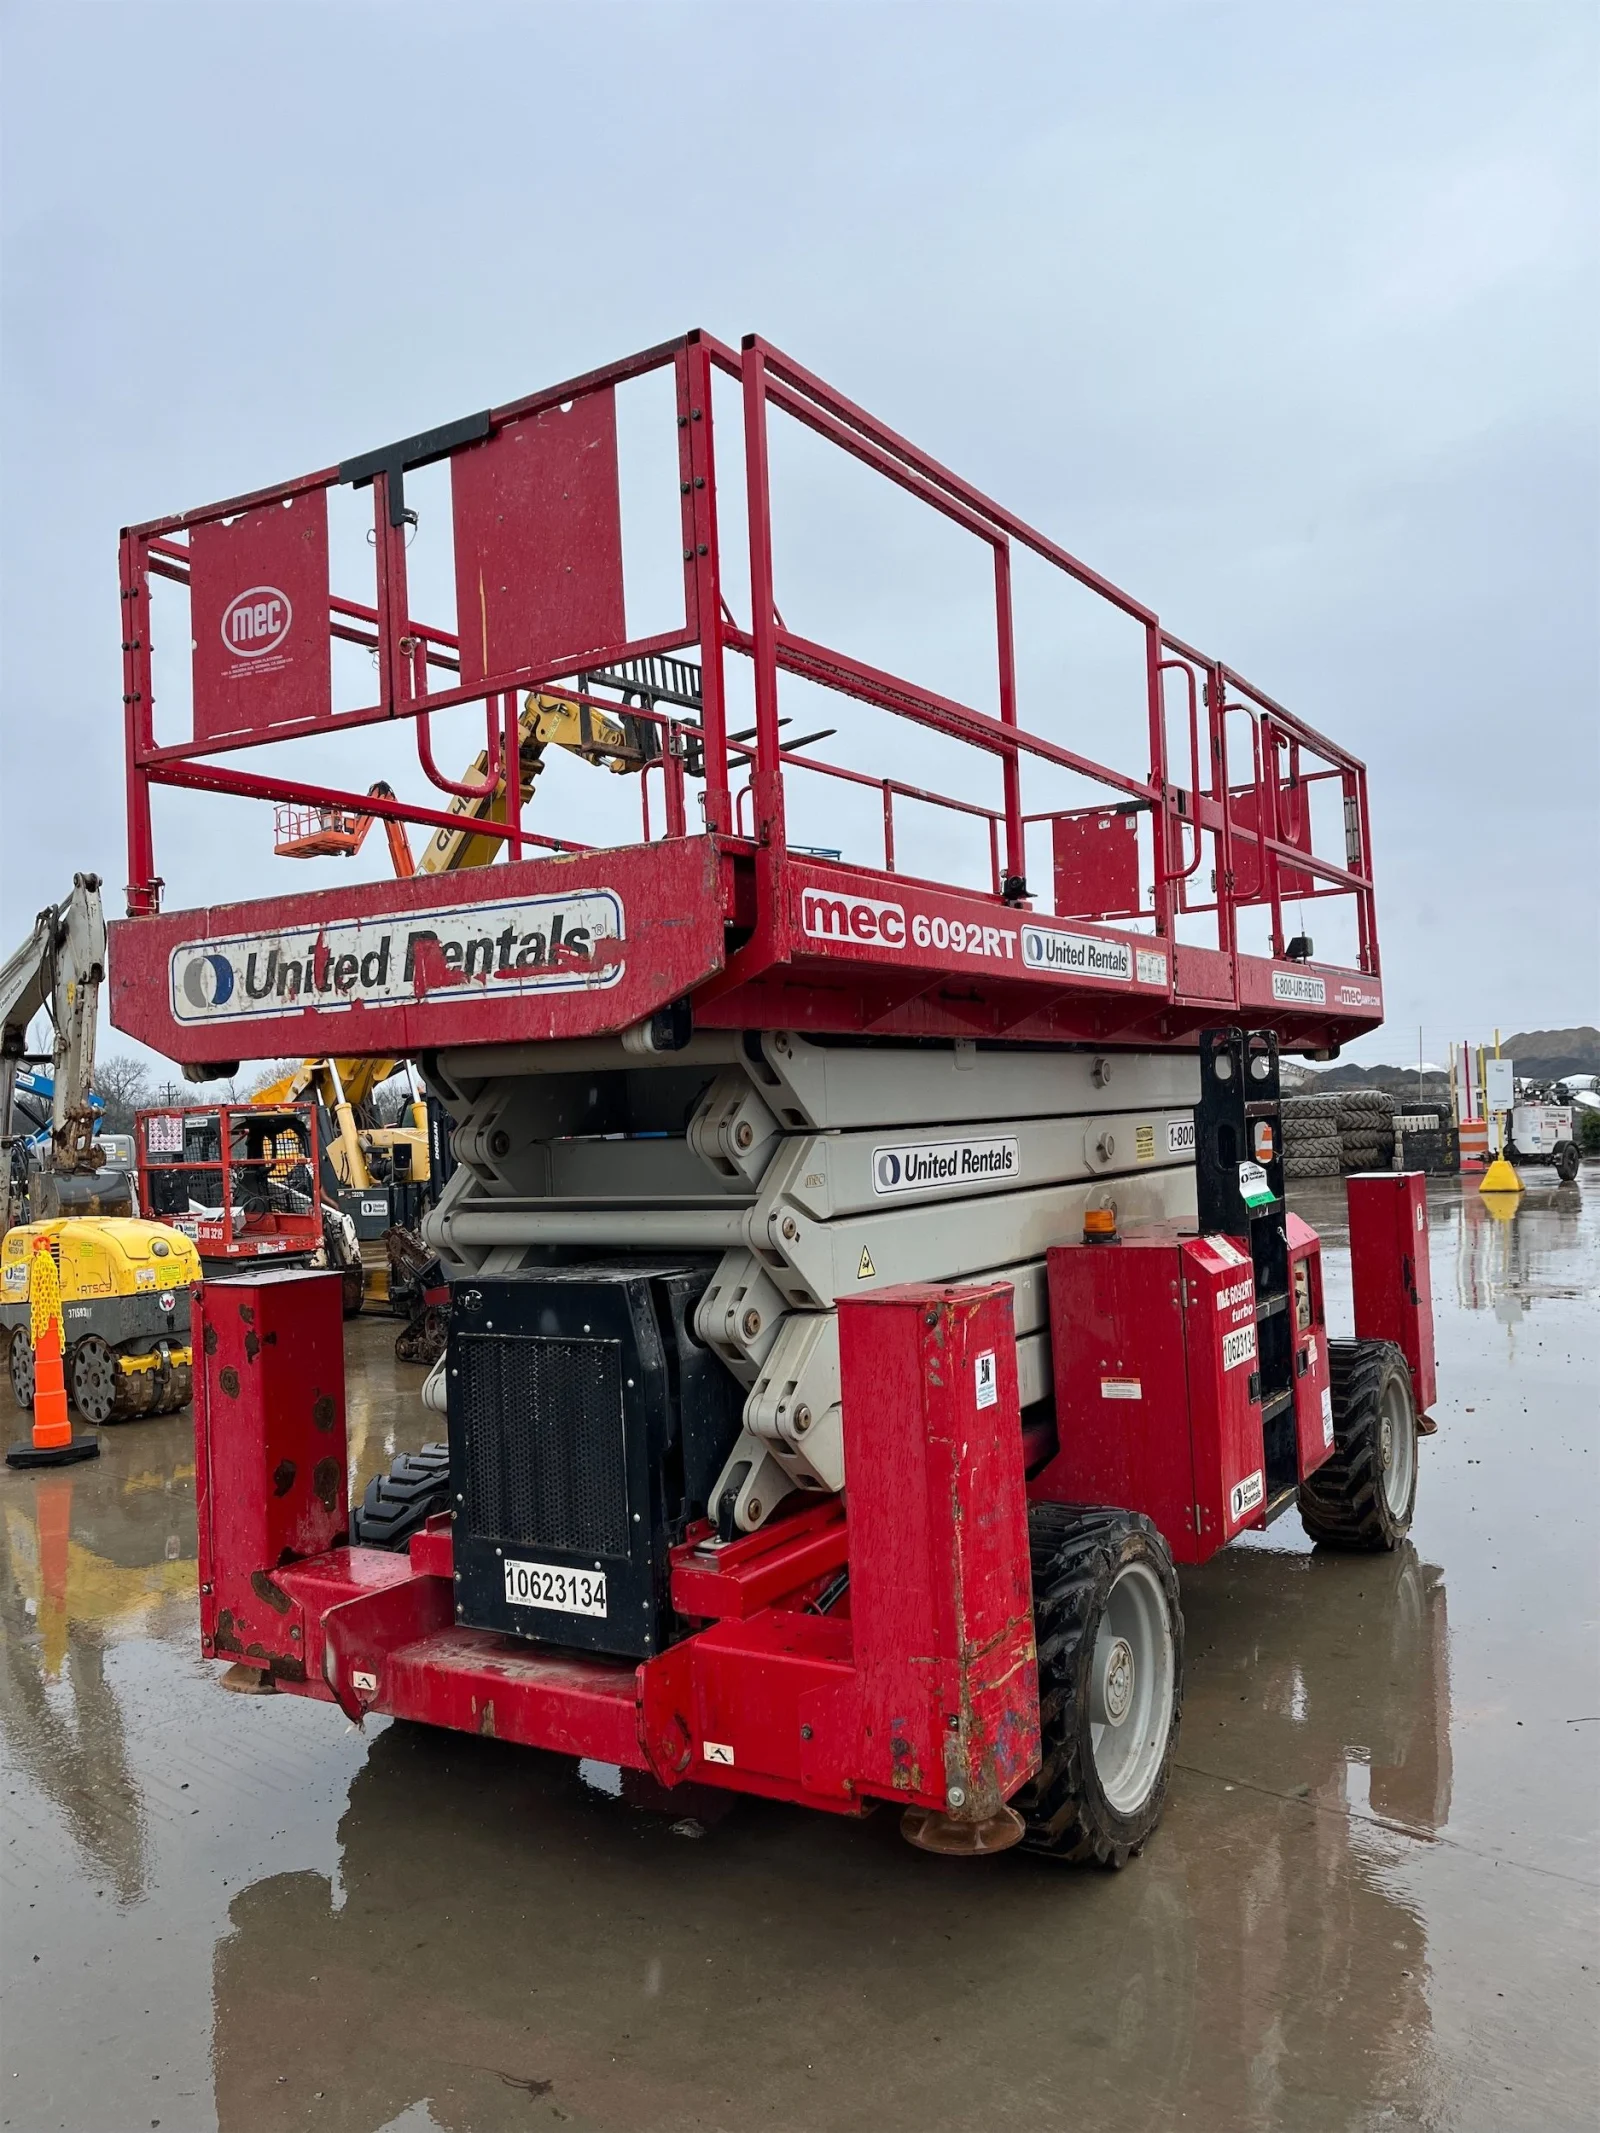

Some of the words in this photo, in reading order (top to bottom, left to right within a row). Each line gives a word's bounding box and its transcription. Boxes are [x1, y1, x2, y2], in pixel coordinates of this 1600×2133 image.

[232, 600, 281, 642] mec
[437, 795, 472, 851] GH
[804, 896, 905, 943] mec
[911, 914, 1017, 960] 6092RT
[246, 936, 391, 999] United
[1046, 938, 1085, 966] United
[1088, 945, 1128, 972] Rentals
[1274, 977, 1324, 1000] 1-800-UR-RENTS
[905, 1150, 958, 1182] United
[961, 1145, 1013, 1174] Rentals
[1230, 1278, 1253, 1305] 6092RT
[1232, 1303, 1254, 1323] turbo
[1242, 1475, 1260, 1496] United
[1243, 1488, 1262, 1508] Rentals
[506, 1567, 606, 1610] 10623134
